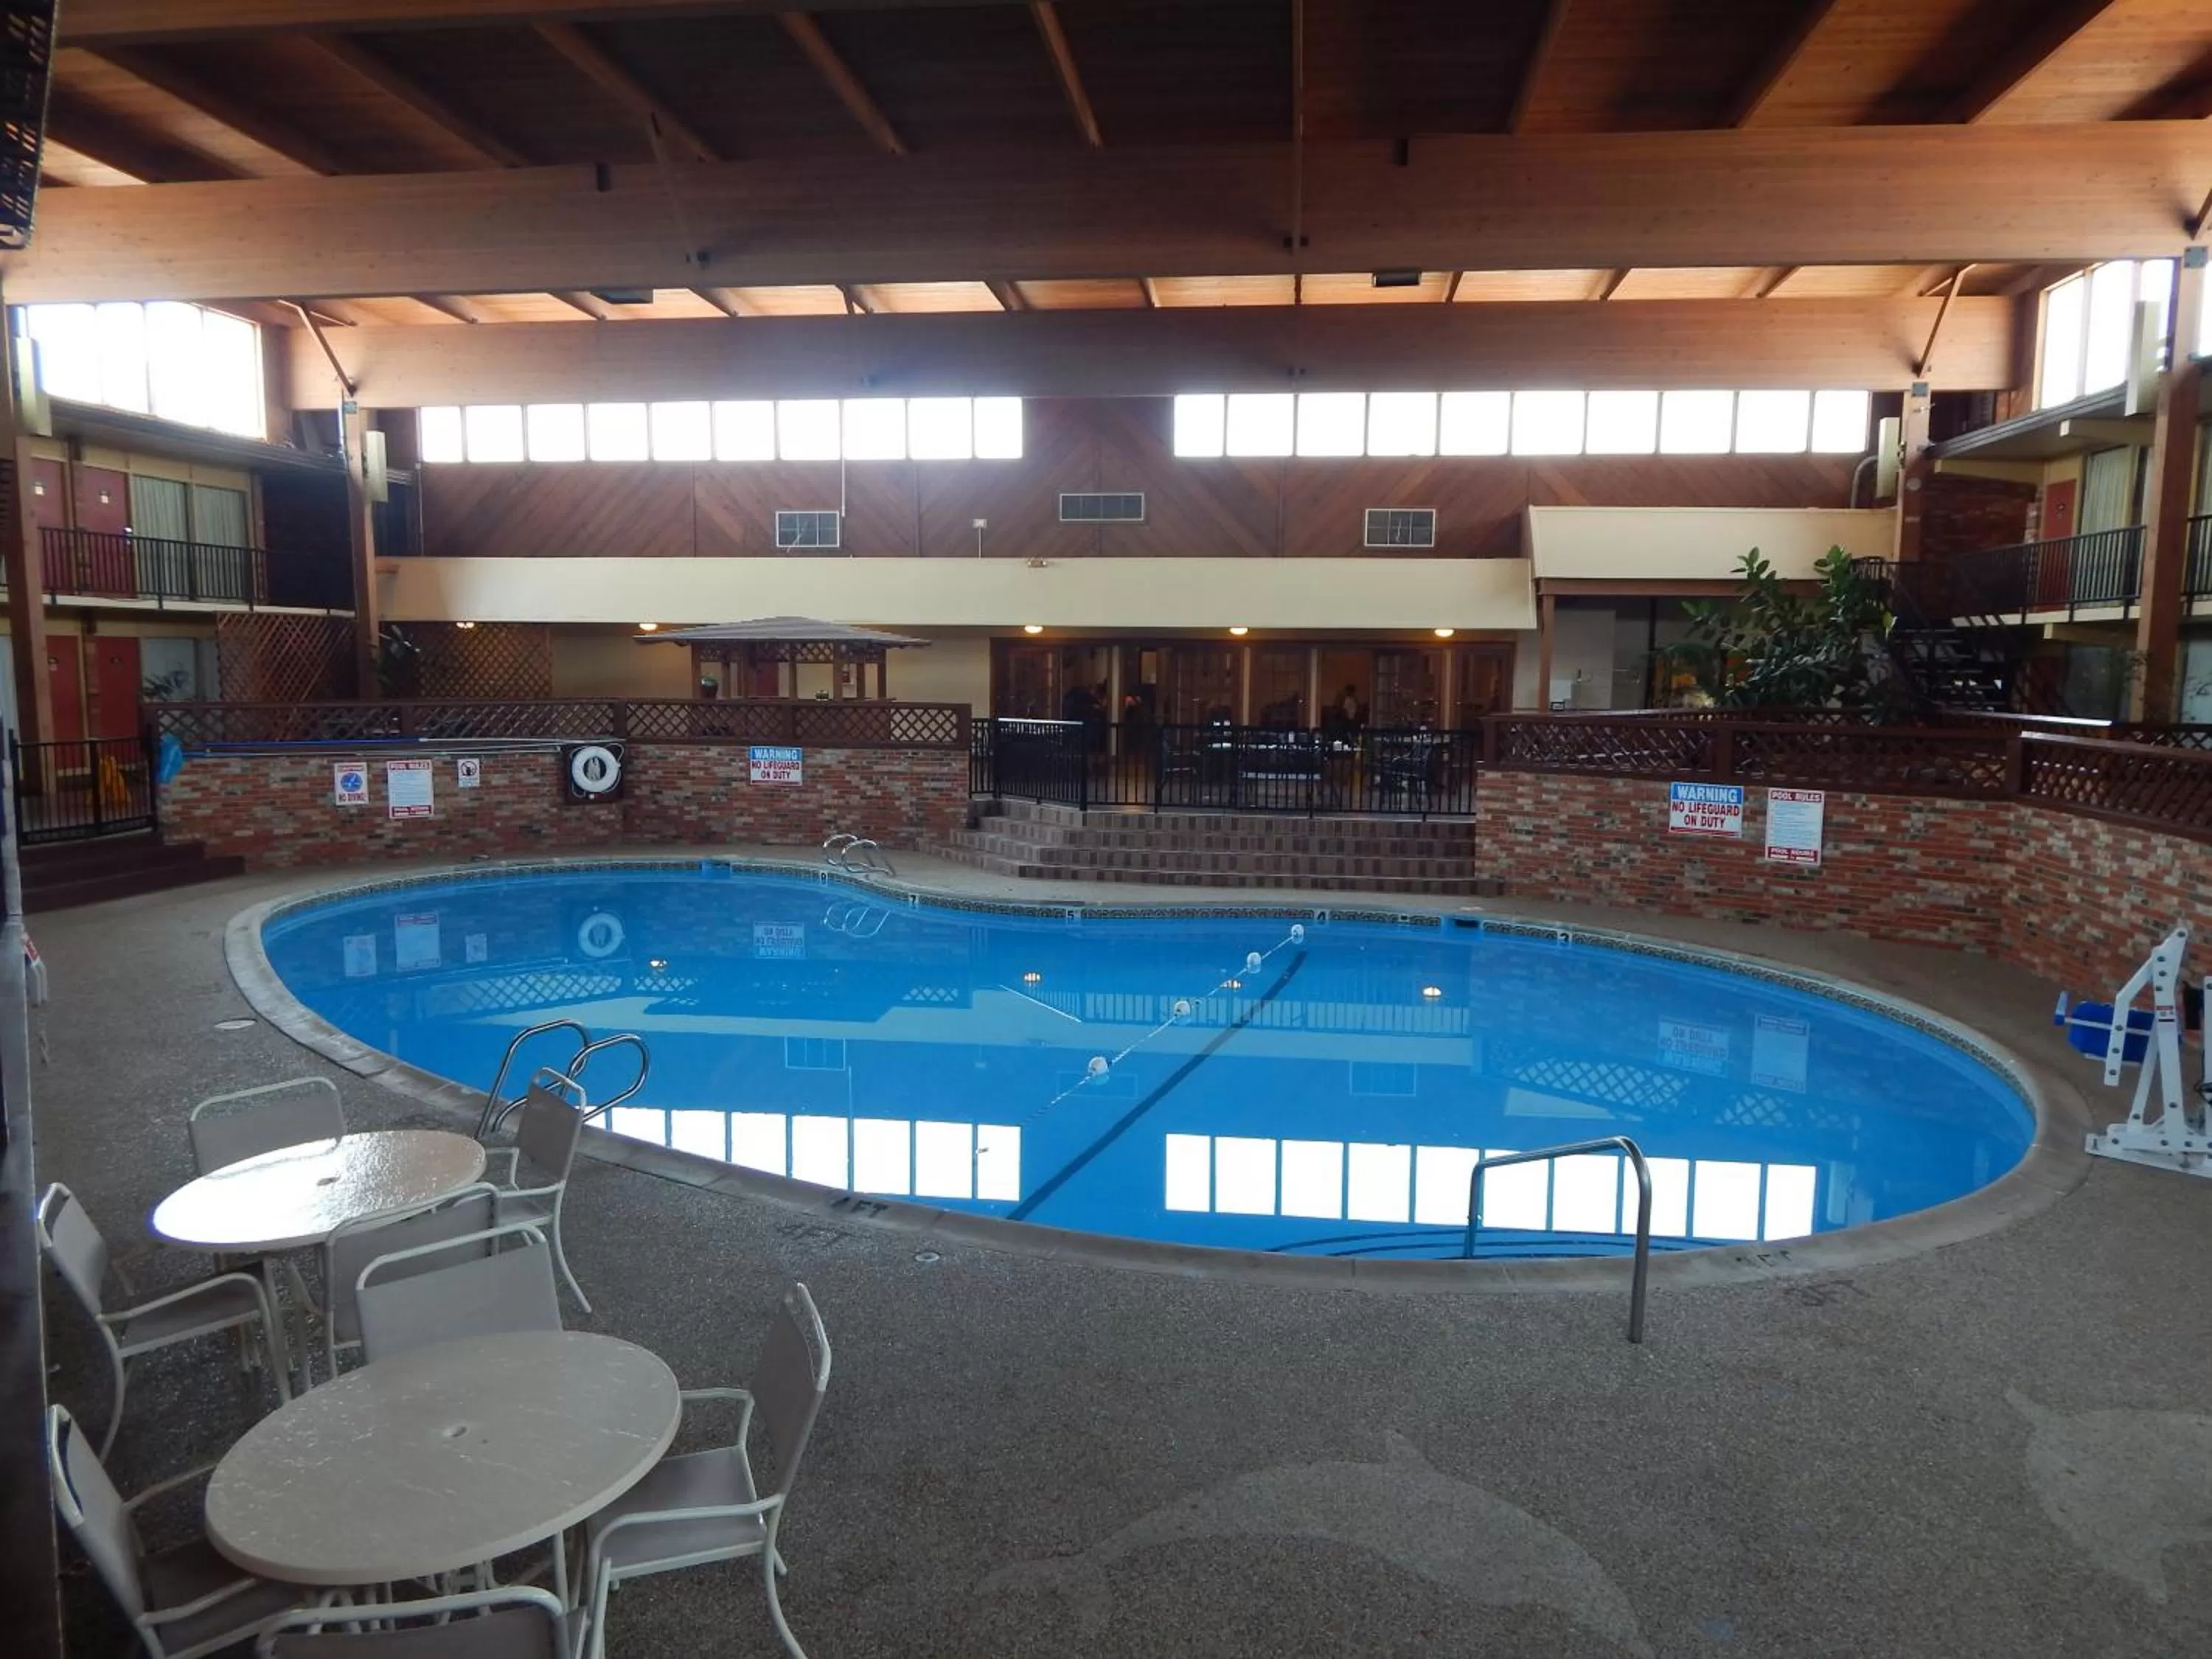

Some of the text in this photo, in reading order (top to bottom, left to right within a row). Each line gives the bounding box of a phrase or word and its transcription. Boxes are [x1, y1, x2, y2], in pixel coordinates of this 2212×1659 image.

[1677, 785, 1738, 803] WARNING
[1772, 791, 1792, 801] POOL
[1672, 802, 1740, 817] NO LIFEGUARD
[1684, 815, 1725, 829] ON DUTY
[1067, 910, 1074, 919] 5
